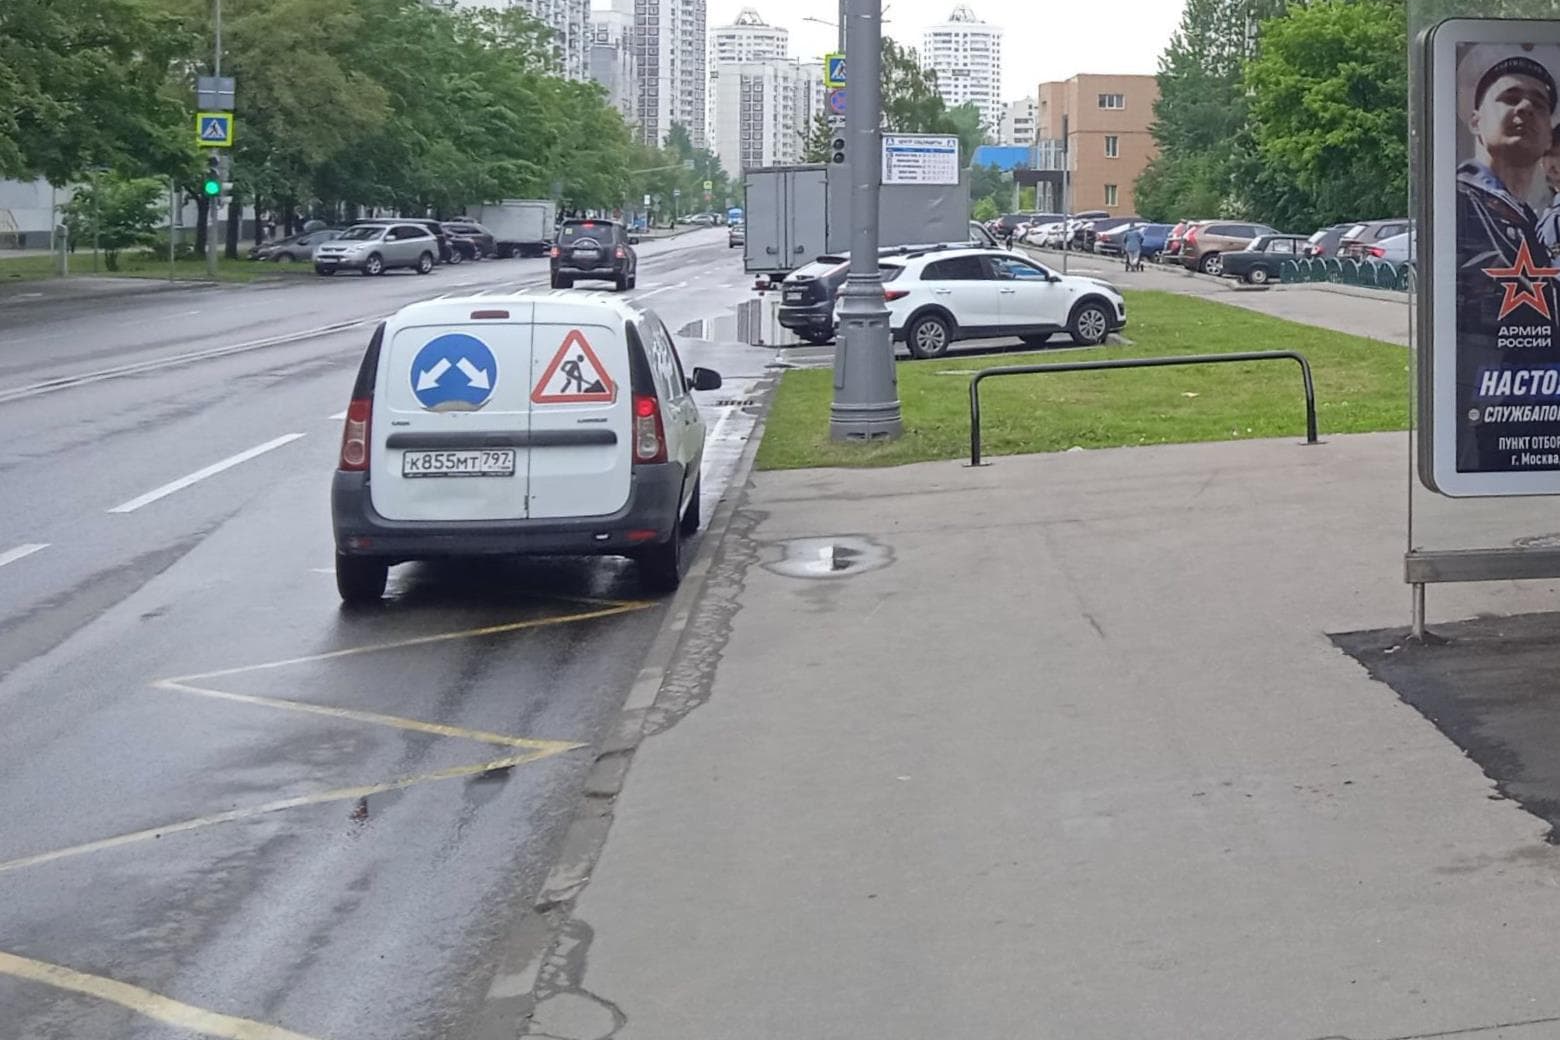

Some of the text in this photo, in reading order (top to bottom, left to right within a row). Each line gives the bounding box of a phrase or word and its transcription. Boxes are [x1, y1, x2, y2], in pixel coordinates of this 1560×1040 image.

[1498, 325, 1551, 336] АРМИЯ
[1498, 337, 1551, 348] РОССИИ
[1498, 435, 1530, 450] ПУНКТ
[409, 452, 509, 471] К855МТ 797
[1511, 454, 1520, 466] г.
